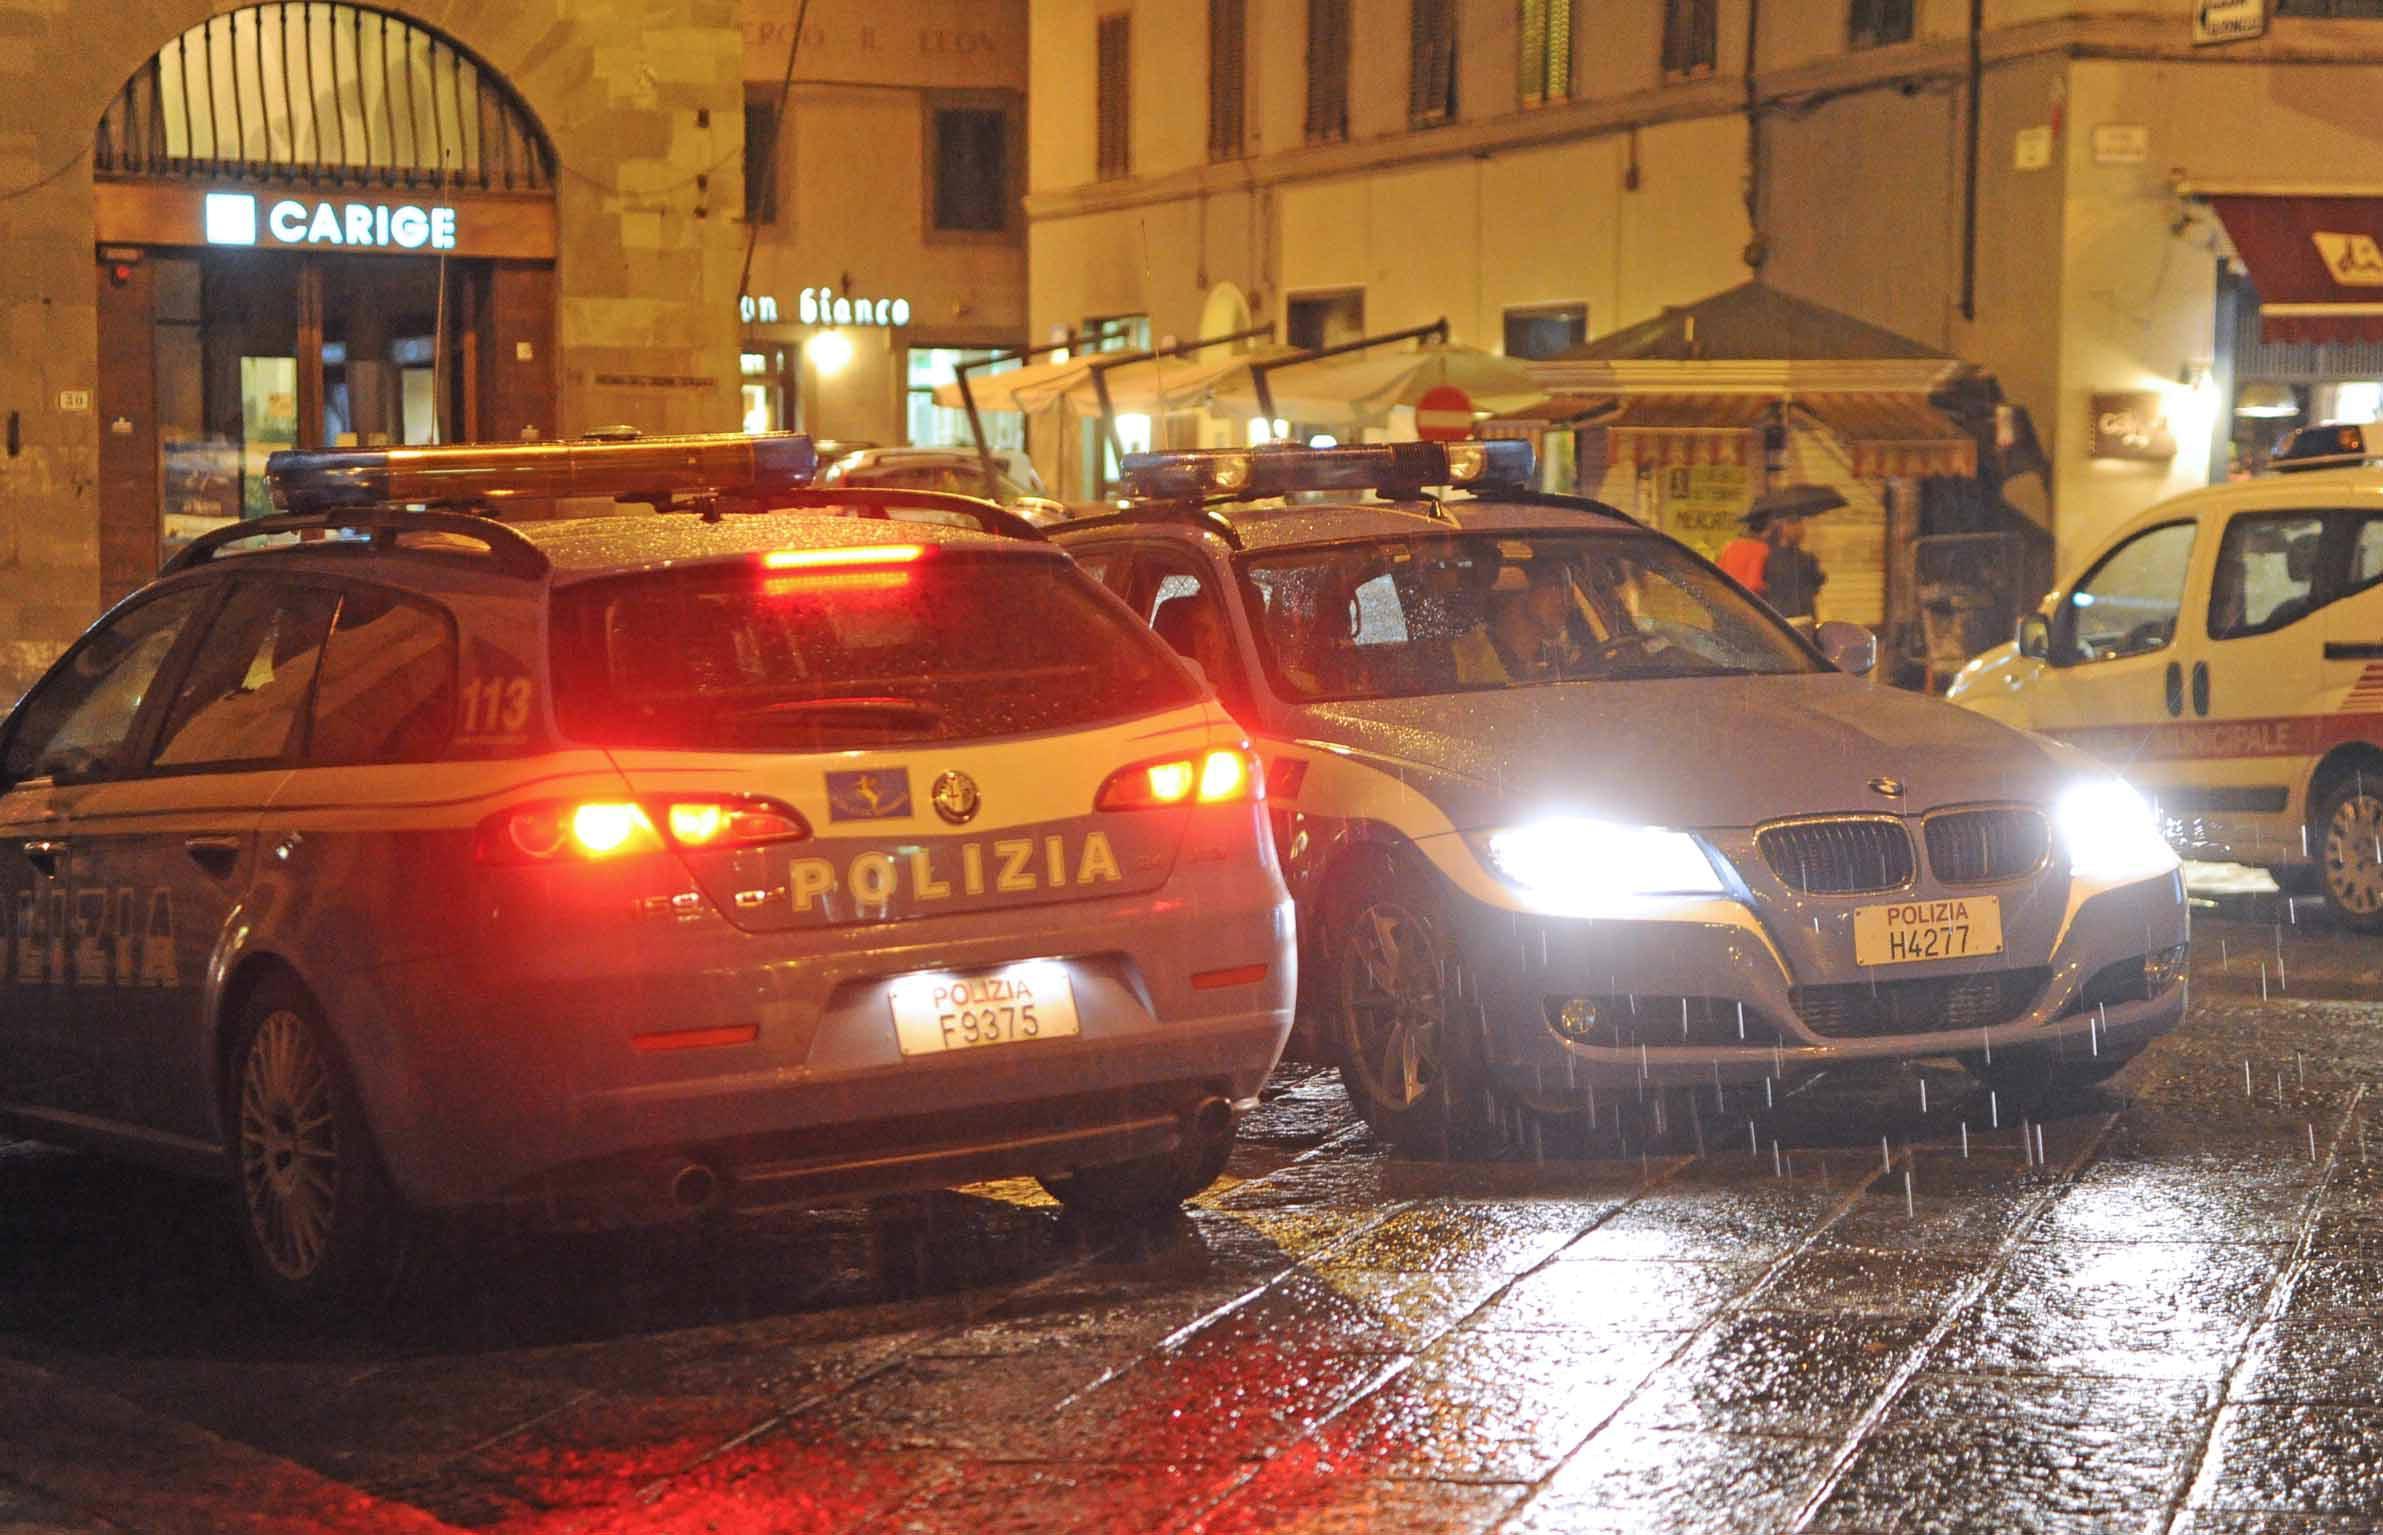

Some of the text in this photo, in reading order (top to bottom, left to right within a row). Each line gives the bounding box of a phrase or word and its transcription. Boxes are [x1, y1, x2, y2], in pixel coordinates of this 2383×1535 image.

[270, 200, 456, 248] CARIGE
[463, 676, 531, 730] 113
[789, 831, 1122, 913] POLIZIA
[1887, 902, 1969, 926] POLIZIA
[1890, 925, 1969, 960] H4277
[933, 979, 1033, 1009] POLIZIA
[940, 1004, 1039, 1049] F9375
